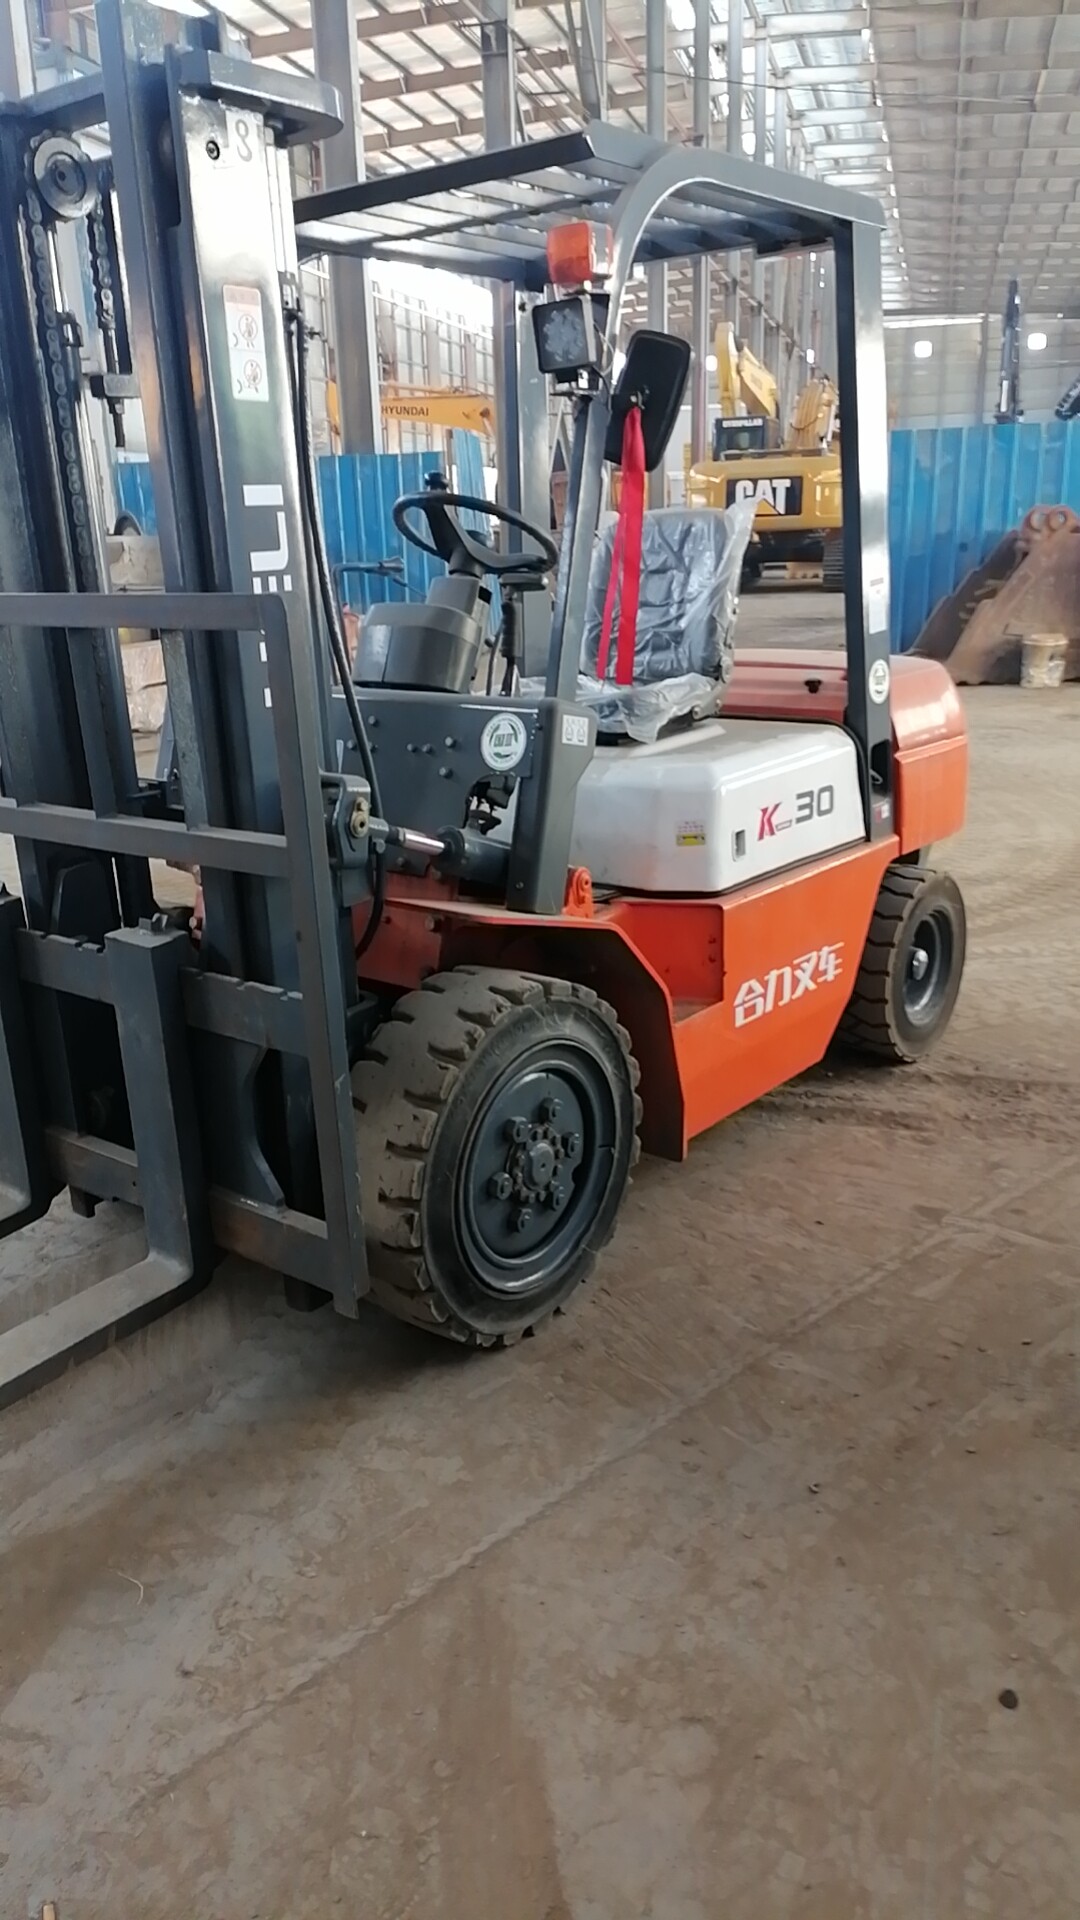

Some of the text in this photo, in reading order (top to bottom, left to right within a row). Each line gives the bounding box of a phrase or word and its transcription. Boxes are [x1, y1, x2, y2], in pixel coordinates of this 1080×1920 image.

[381, 405, 429, 417] HYUNDAI
[735, 479, 791, 515] CAT
[733, 941, 845, 1028] 合力叉车
